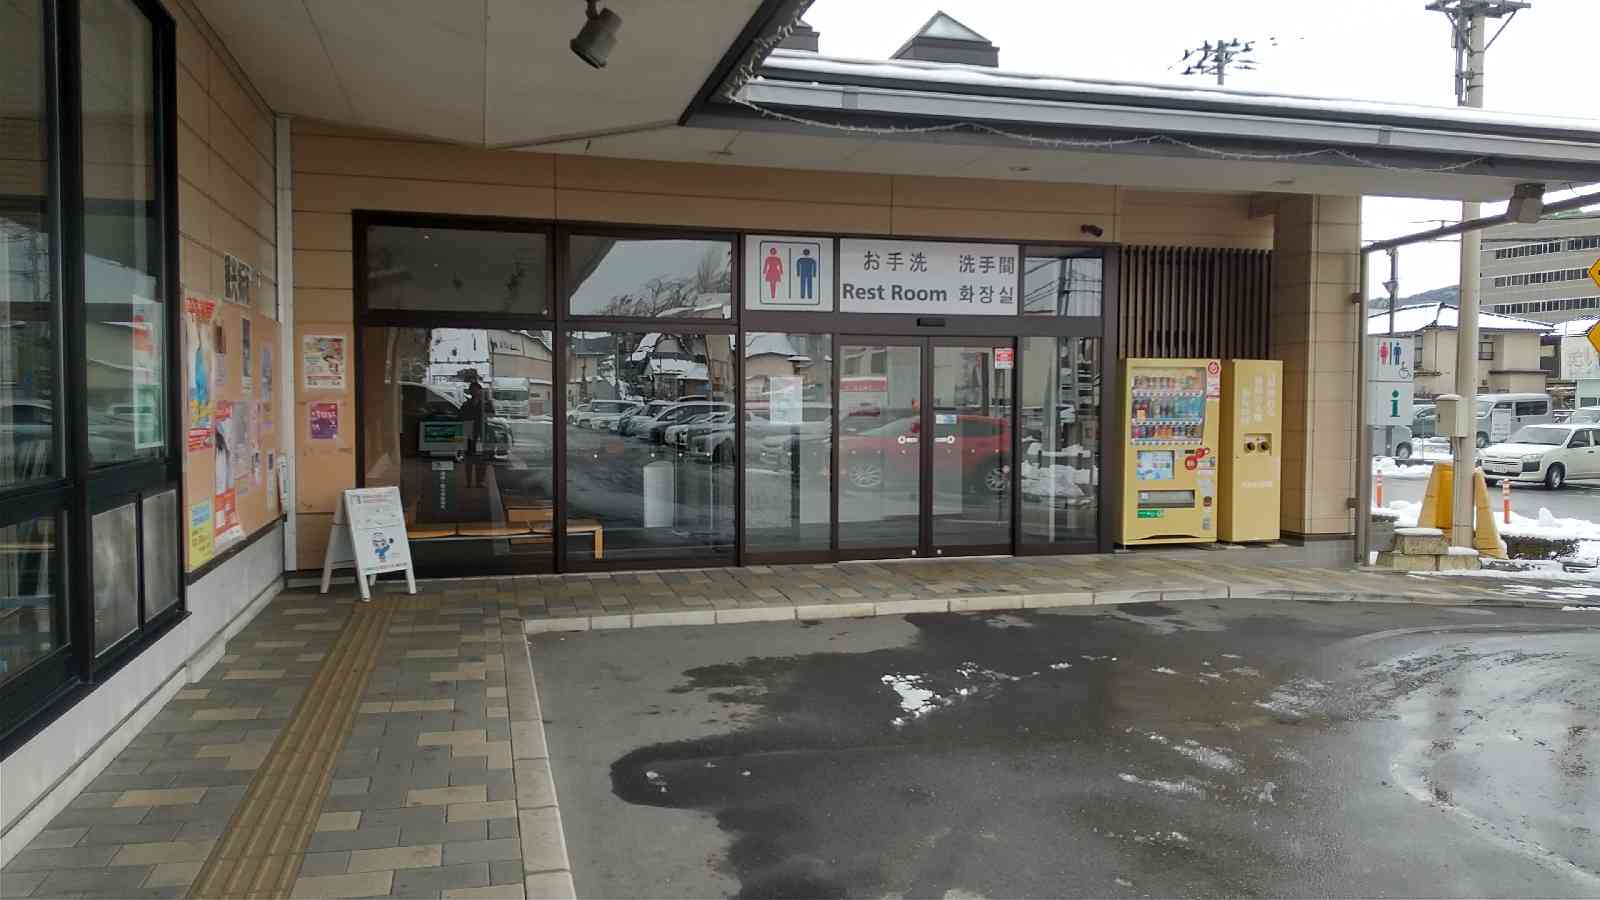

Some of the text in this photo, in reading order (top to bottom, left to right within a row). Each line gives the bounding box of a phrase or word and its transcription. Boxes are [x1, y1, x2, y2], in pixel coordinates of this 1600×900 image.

[863, 250, 928, 273] お手洗
[842, 283, 947, 302] Rest Room
[959, 285, 1014, 304] 화장실
